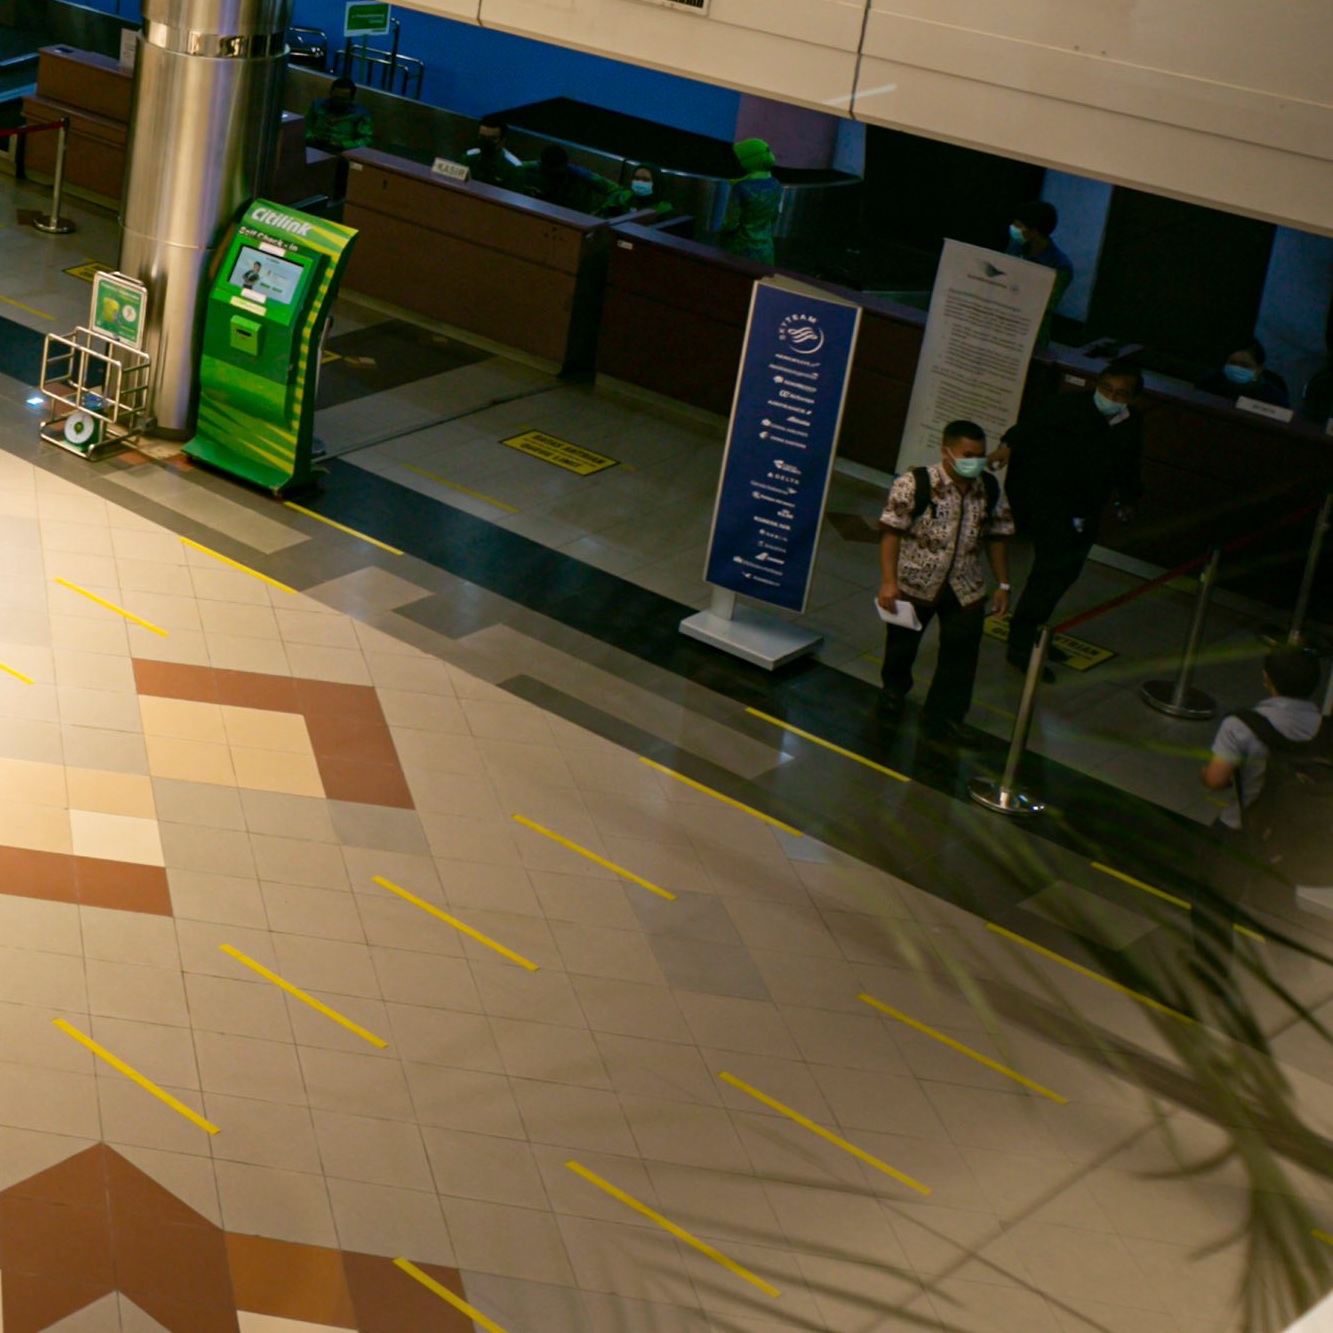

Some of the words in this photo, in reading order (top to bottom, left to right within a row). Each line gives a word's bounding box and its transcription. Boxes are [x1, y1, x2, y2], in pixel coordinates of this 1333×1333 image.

[436, 161, 466, 177] KASIR
[238, 226, 257, 237] Self
[251, 208, 311, 237] Citilink
[779, 313, 818, 341] SKYTEAM
